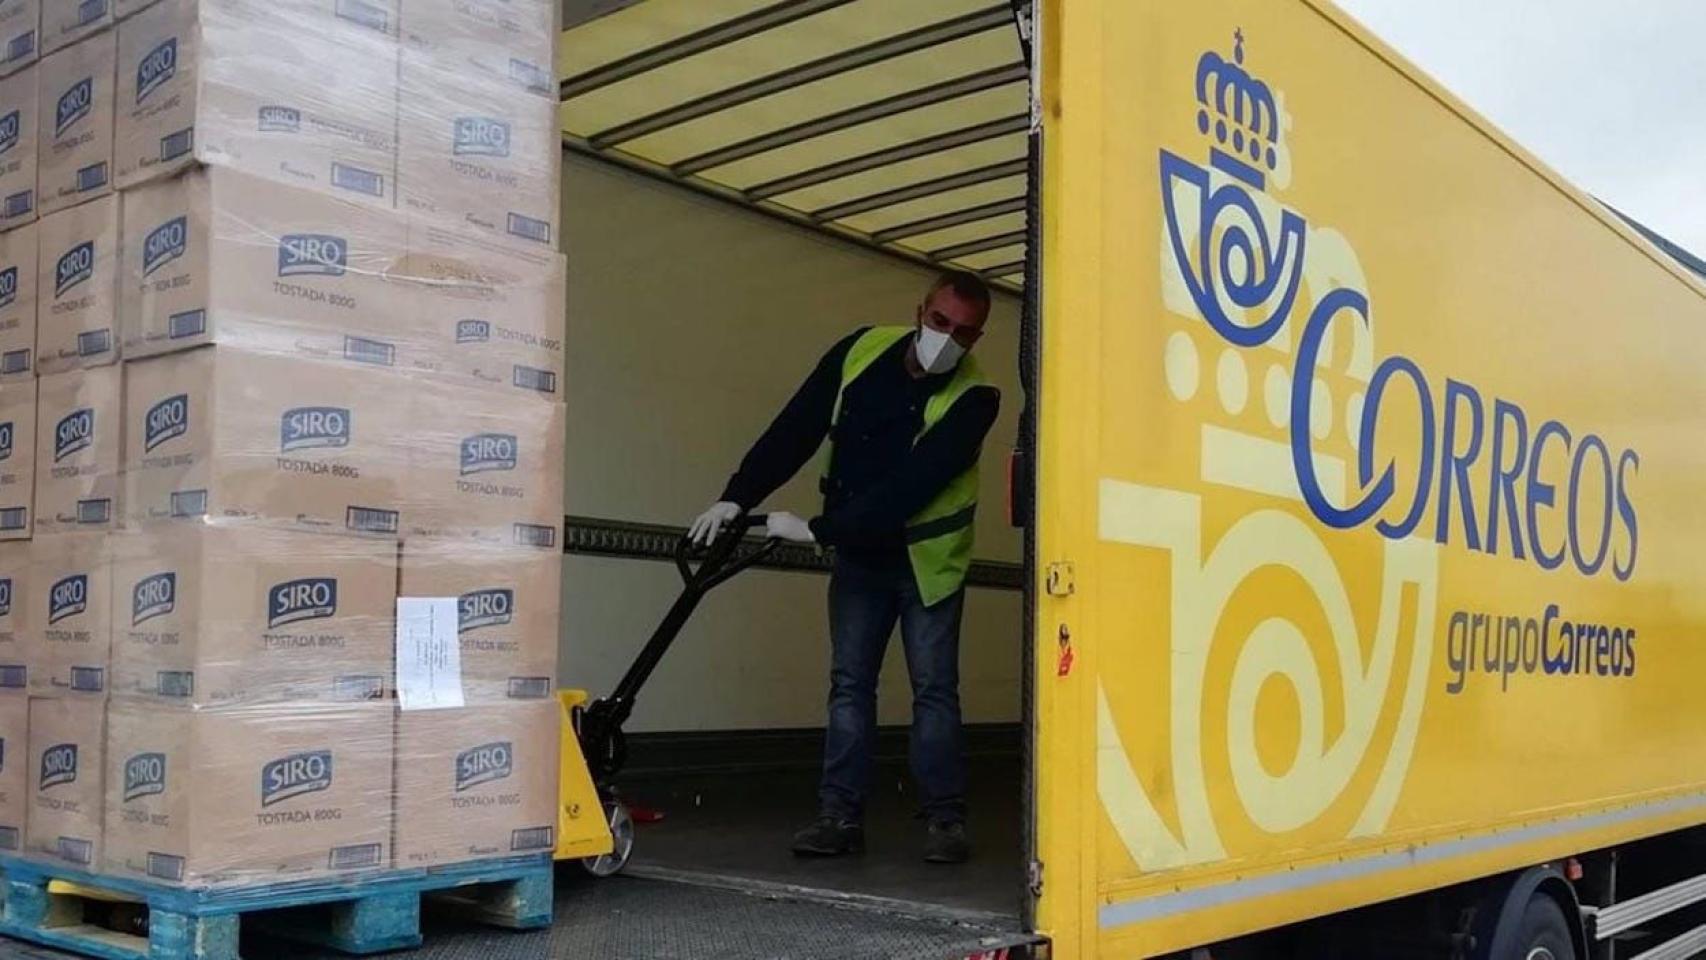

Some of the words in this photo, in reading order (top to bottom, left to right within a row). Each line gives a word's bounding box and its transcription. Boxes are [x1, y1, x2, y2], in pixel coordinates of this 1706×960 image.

[461, 121, 506, 146] SIRO
[147, 223, 183, 262] SIRO
[285, 238, 341, 264] SIRO
[60, 246, 90, 285] SIRO
[272, 280, 326, 303] TOSTADA
[59, 414, 90, 448] SIRO
[149, 400, 184, 437] SIRO
[289, 410, 344, 439] SIRO
[467, 438, 512, 463] SIRO
[1291, 288, 1640, 582] CORREOS
[277, 457, 329, 475] TOSTADA
[54, 580, 84, 611] SIRO
[137, 578, 171, 611] SIRO
[276, 582, 330, 613] SIRO
[463, 593, 508, 621] SIRO
[1446, 604, 1636, 694] grupoCorreos
[44, 749, 73, 778] SIRO
[127, 758, 161, 788] SIRO
[270, 755, 325, 791] SIRO
[462, 746, 507, 779] SIRO
[256, 810, 311, 825] TOSTADA
